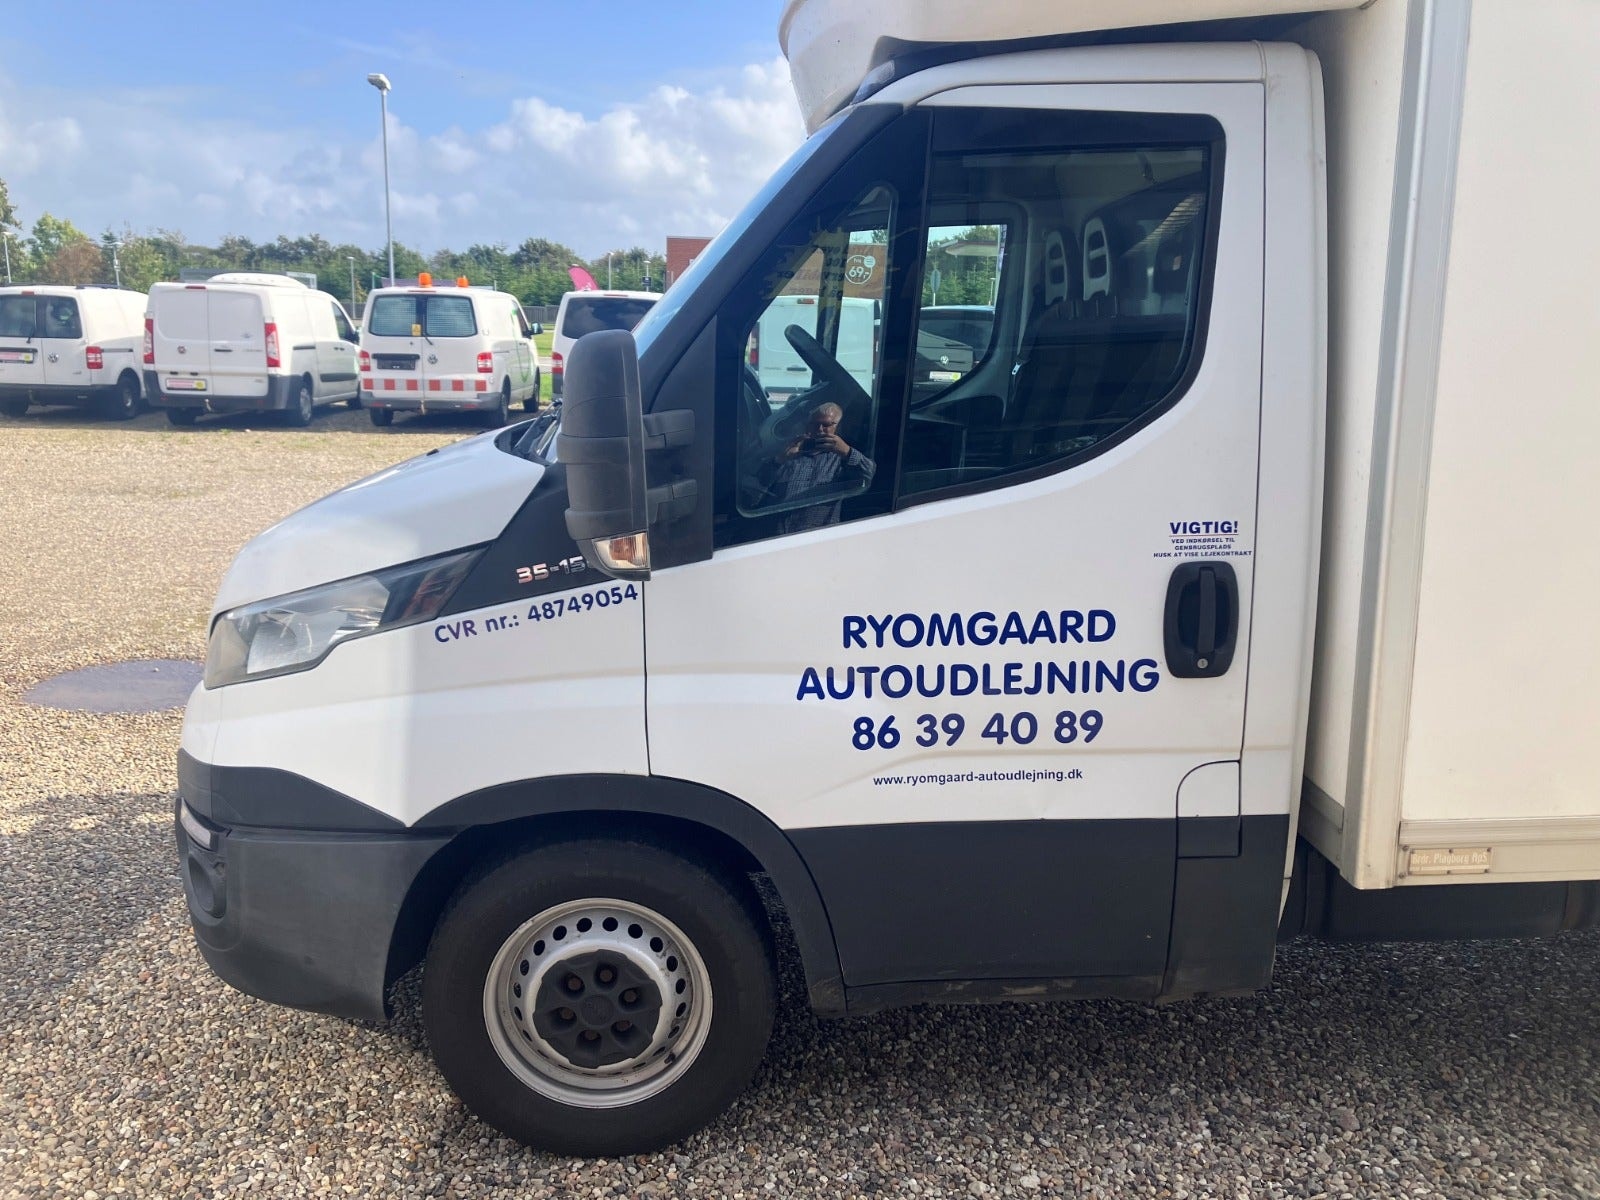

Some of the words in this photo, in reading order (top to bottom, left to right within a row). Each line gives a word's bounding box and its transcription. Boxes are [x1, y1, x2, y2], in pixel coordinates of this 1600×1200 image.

[1170, 520, 1238, 534] VIGTIG!
[434, 619, 478, 643] CVR
[485, 612, 520, 633] nr.:
[527, 583, 638, 622] 48749054
[842, 609, 1117, 649] RYOMGAARD
[796, 658, 1160, 701] AUTOUDLEJNING
[852, 715, 901, 751] 86
[915, 713, 966, 747] 39
[981, 711, 1038, 745] 40
[1053, 709, 1104, 744] 89
[872, 768, 1084, 787] www.ryomgaard-autoudlejning.dk
